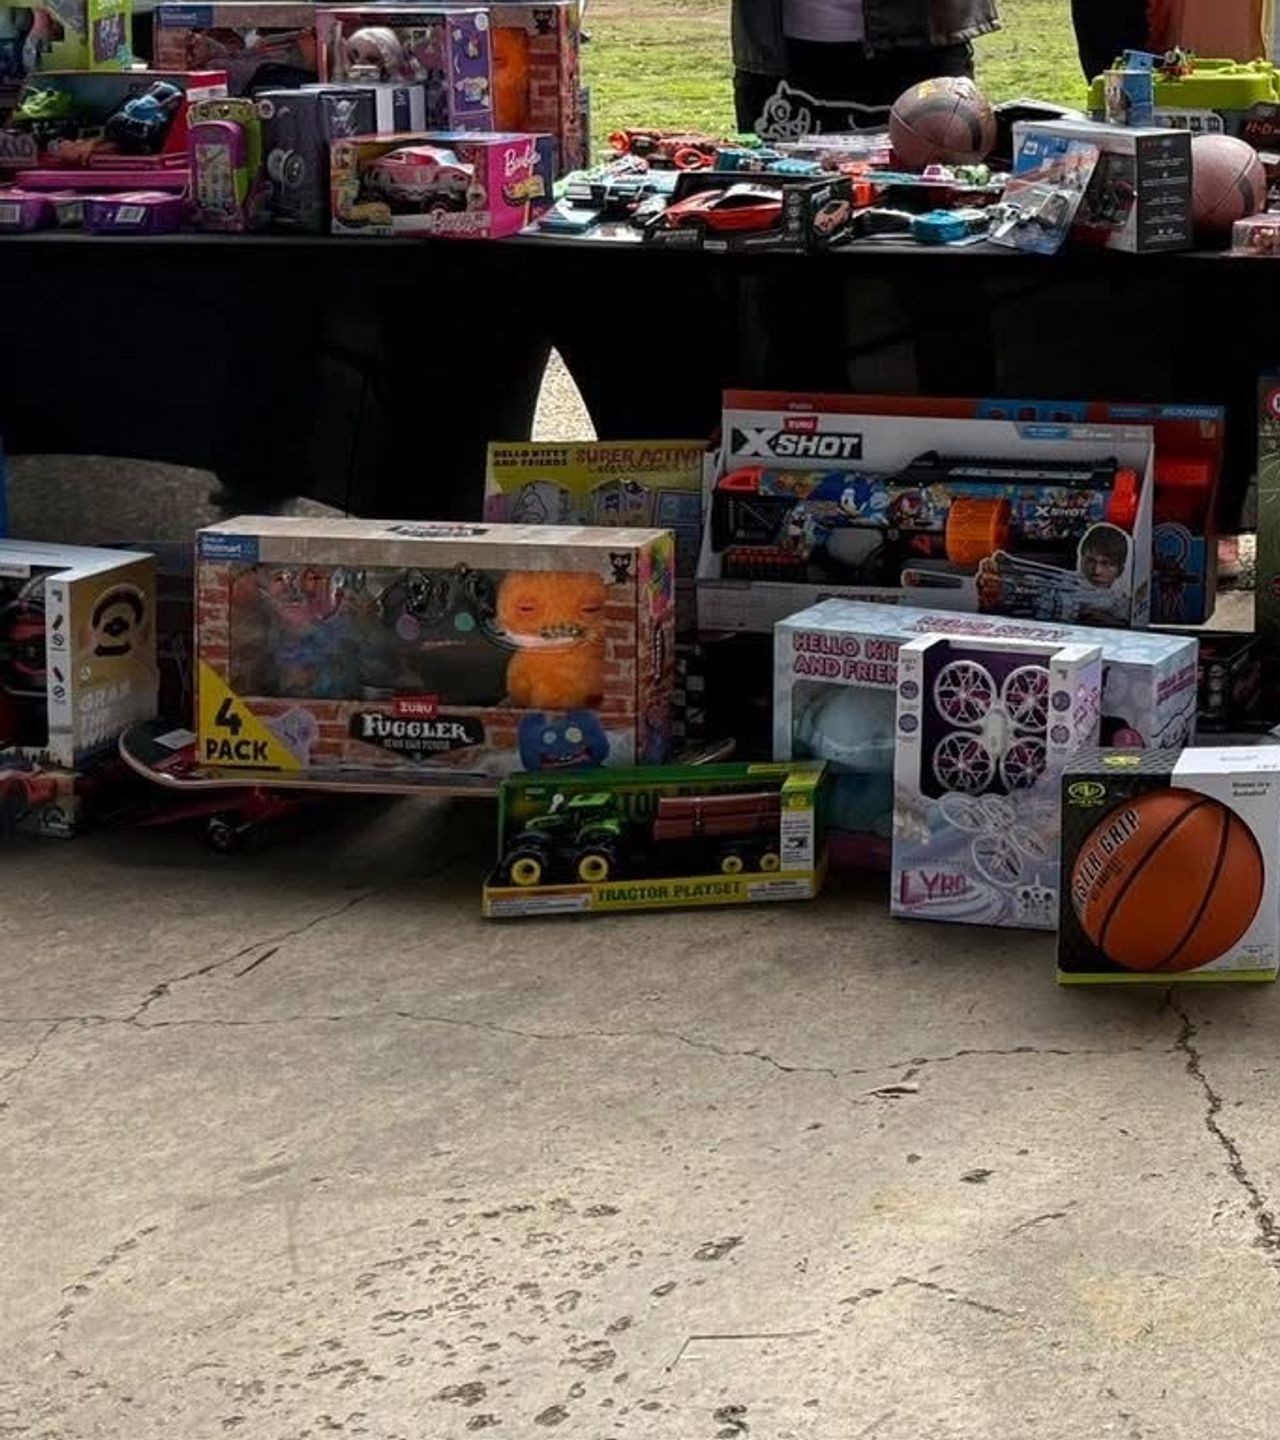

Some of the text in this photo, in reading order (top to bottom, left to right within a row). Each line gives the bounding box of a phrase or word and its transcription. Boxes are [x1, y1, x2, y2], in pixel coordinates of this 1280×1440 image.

[503, 146, 541, 175] Barbie
[793, 631, 859, 658] HELLO
[793, 655, 841, 677] AND
[214, 696, 243, 737] 4
[361, 714, 472, 742] FUGGLER
[206, 739, 268, 760] PACK
[1101, 808, 1139, 857] GRIP
[598, 881, 740, 902] TRACTOR PLAYSET
